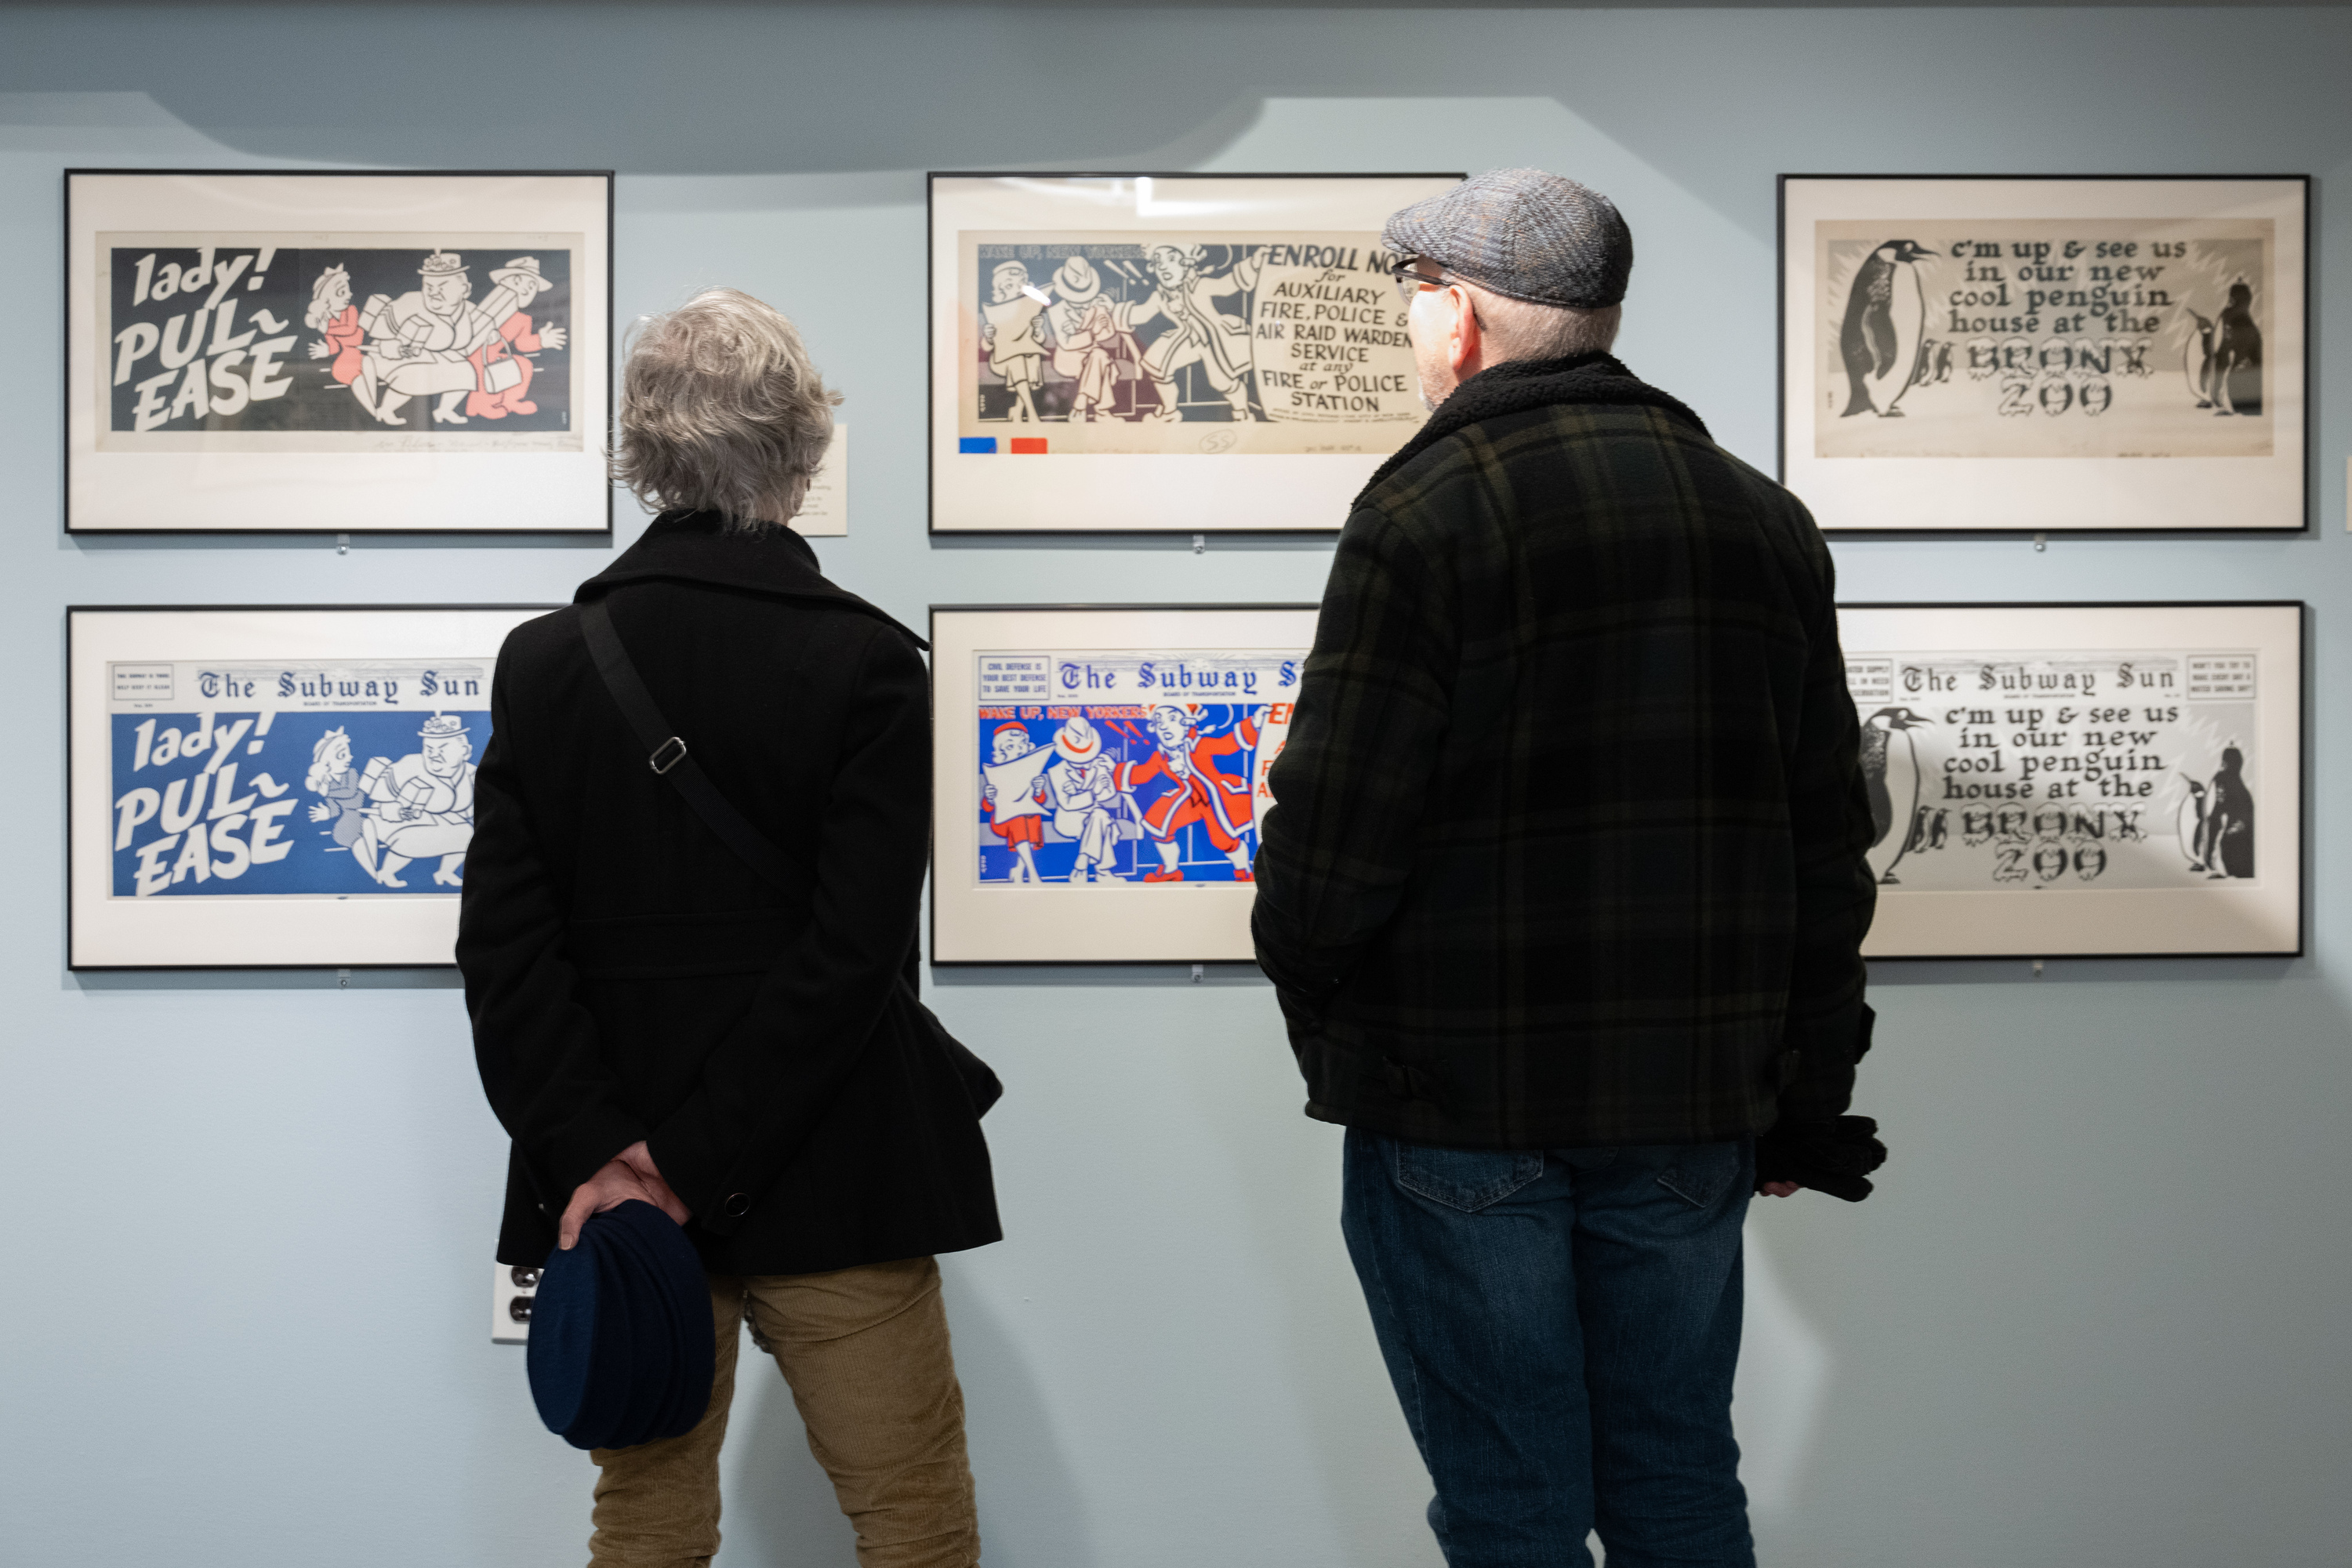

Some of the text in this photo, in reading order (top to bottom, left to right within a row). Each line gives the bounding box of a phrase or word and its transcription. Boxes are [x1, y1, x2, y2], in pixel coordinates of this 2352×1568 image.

[1268, 244, 1406, 275] ENROLL NO
[2012, 241, 2051, 265] up
[2063, 241, 2086, 258] &
[2096, 241, 2138, 258] see
[2152, 241, 2187, 258] us
[133, 247, 276, 310] lady!
[1315, 269, 1345, 283] for
[1965, 260, 2165, 281] in our new
[1273, 281, 1386, 305] AUXILIARY
[1949, 282, 2175, 316] cool penguin
[1314, 303, 1385, 325] POLICE
[1948, 309, 2160, 333] house at the
[1255, 323, 1285, 339] AIR
[1294, 324, 1336, 341] RAID
[1290, 343, 1369, 362] SERVICE
[1966, 336, 2154, 381] BRONX
[1299, 361, 1353, 375] at any
[132, 335, 298, 432] EASE
[1261, 369, 1408, 393] FIRE or POLICE
[1291, 392, 1379, 412] STATION
[1998, 374, 2112, 416] ZOO
[198, 670, 479, 704] The Subway Sun
[1059, 662, 1116, 689] The
[1138, 662, 1258, 695] Subway
[1902, 662, 2174, 696] The Subway Sun
[978, 706, 1016, 719] WAKE
[1047, 706, 1082, 719] NEW
[1085, 706, 1149, 719] YORKERS
[2005, 708, 2044, 731] up
[2057, 706, 2078, 724] &
[2089, 707, 2131, 722] see
[2144, 706, 2179, 722] us
[133, 712, 276, 775] lady!
[1959, 728, 2158, 747] in our new
[1944, 747, 2168, 782] cool penguin
[1943, 774, 2154, 799] house at the
[1961, 801, 2147, 848] BRONX
[133, 798, 299, 896] EASE
[1993, 839, 2107, 882] ZOO
